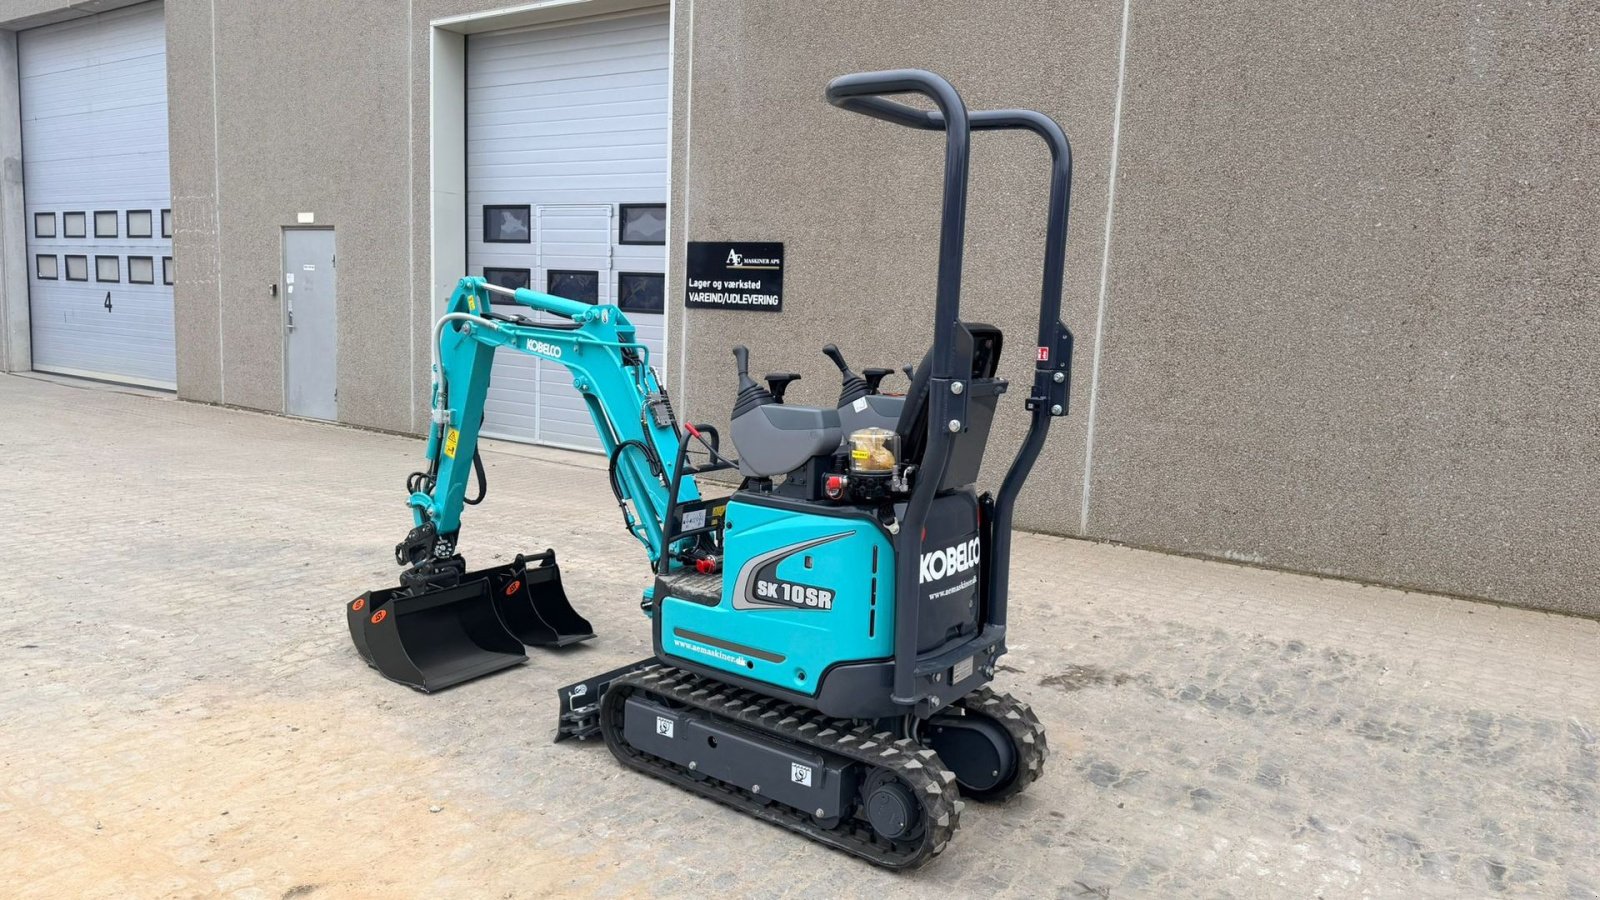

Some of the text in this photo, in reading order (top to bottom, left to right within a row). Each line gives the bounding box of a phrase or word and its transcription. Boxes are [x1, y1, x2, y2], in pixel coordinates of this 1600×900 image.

[726, 248, 743, 267] AE
[689, 278, 761, 290] Lager og værksted
[104, 291, 113, 313] 4
[689, 292, 778, 305] VAREIND/UDLEVERING
[526, 338, 562, 358] KOBELCO
[919, 537, 980, 584] KOBELCO
[757, 580, 833, 609] SK 10SR
[674, 640, 746, 667] www.aemaskiner.dk
